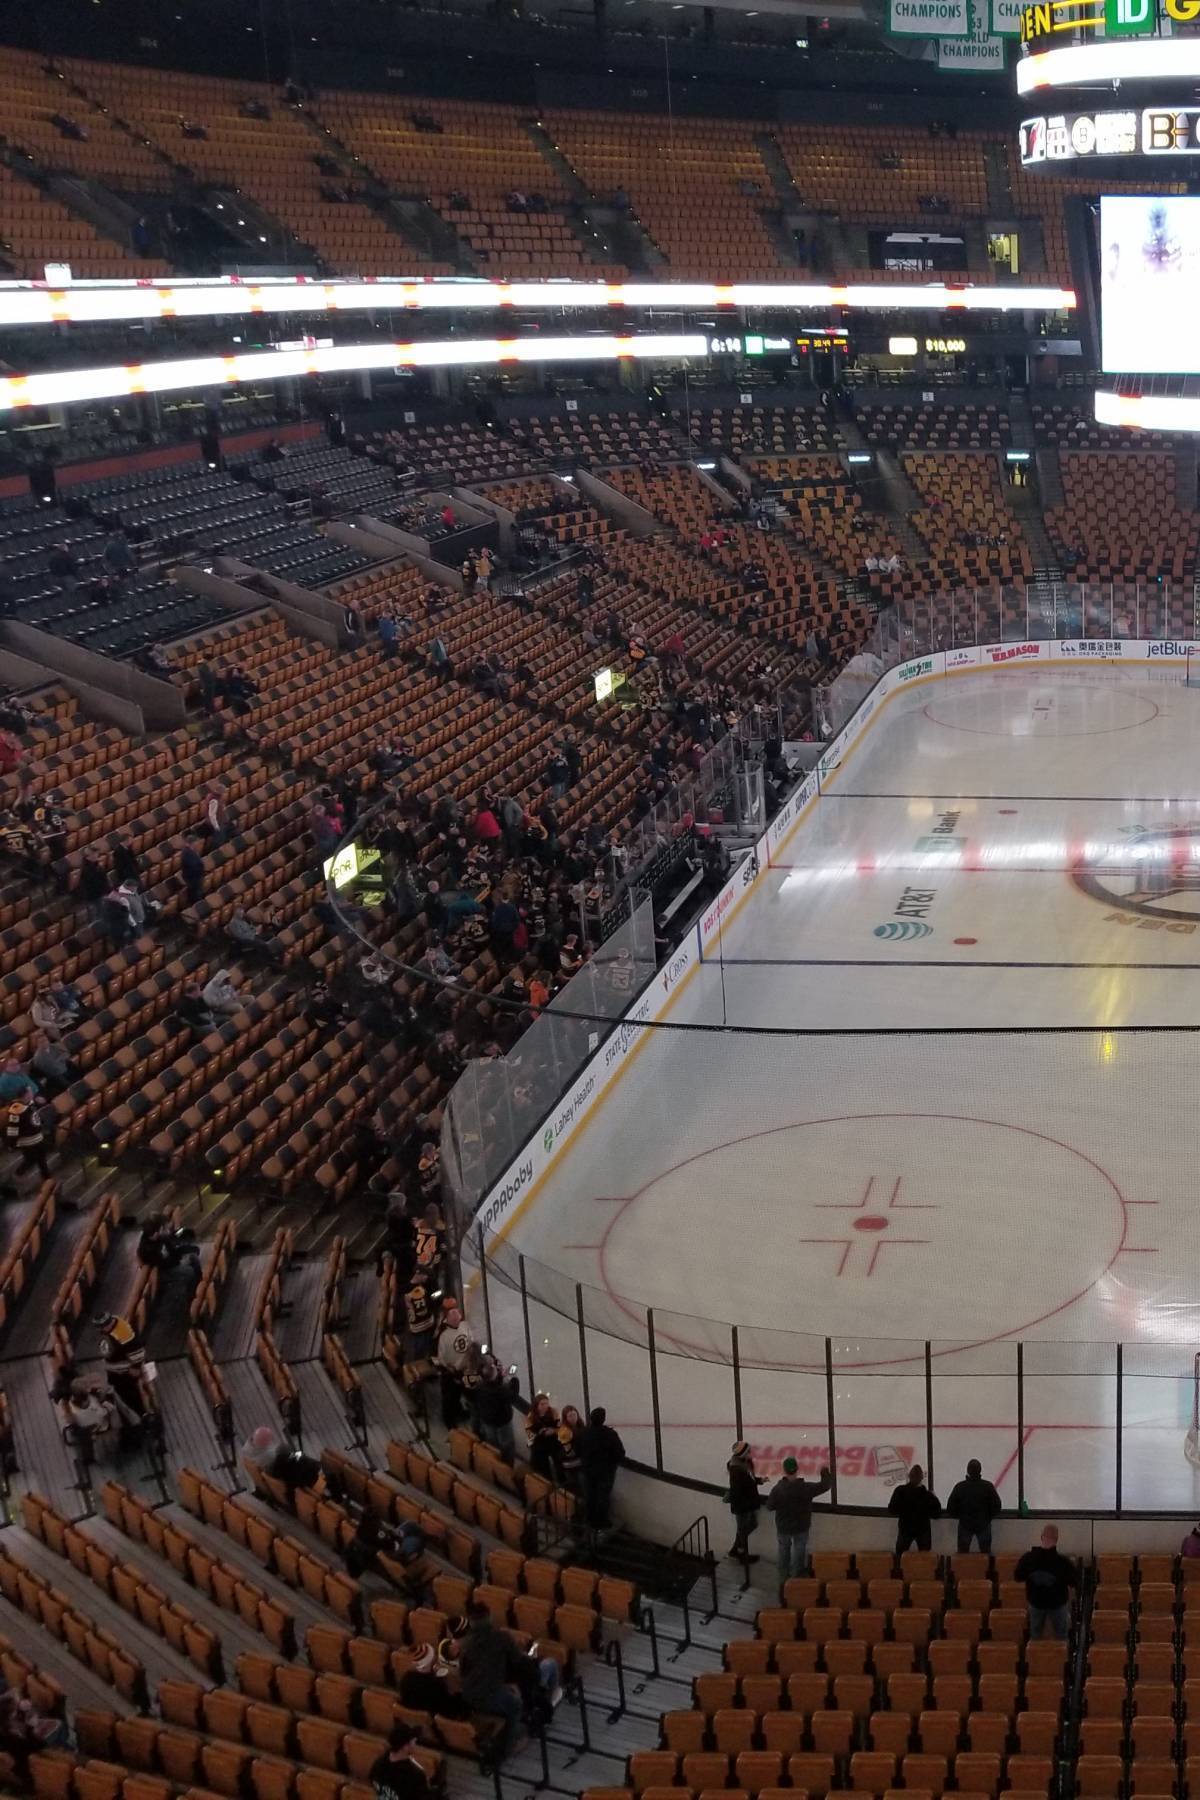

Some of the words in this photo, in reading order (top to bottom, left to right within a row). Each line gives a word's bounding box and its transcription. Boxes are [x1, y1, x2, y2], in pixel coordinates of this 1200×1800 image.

[895, 3, 962, 19] CHAMPIONS
[943, 43, 1001, 58] CHAMPIONS
[925, 339, 966, 353] $10,000
[1147, 641, 1196, 658] jetBlue
[931, 810, 961, 834] Bank
[893, 886, 938, 919] AT&T
[554, 1101, 575, 1137] Lahey
[573, 1076, 595, 1111] Health
[632, 1683, 646, 1695] 5
